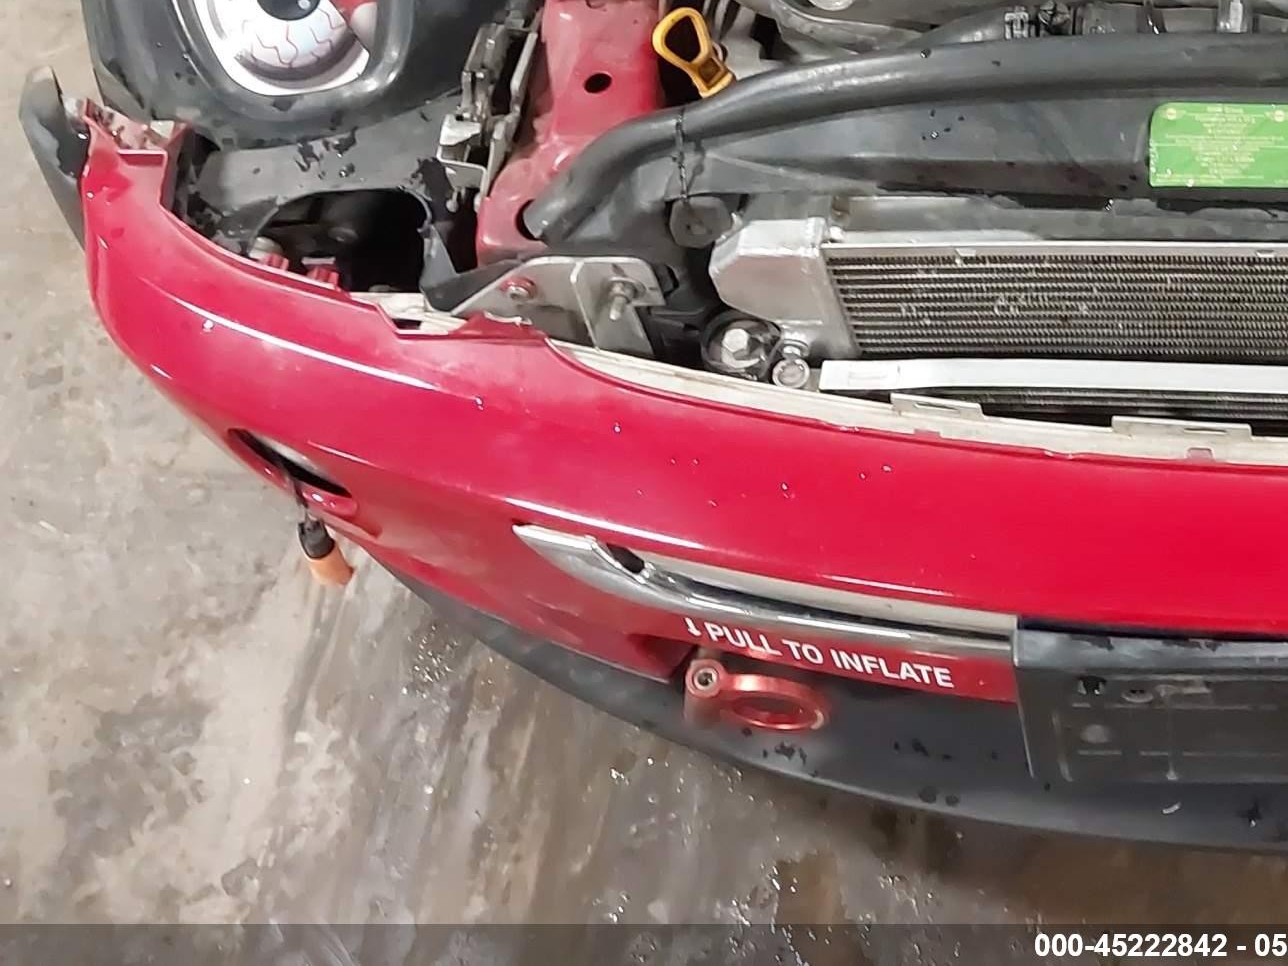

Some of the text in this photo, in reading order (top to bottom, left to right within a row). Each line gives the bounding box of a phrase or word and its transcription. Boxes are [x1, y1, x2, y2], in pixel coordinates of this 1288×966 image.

[703, 621, 955, 689] PULL TO INFLATE
